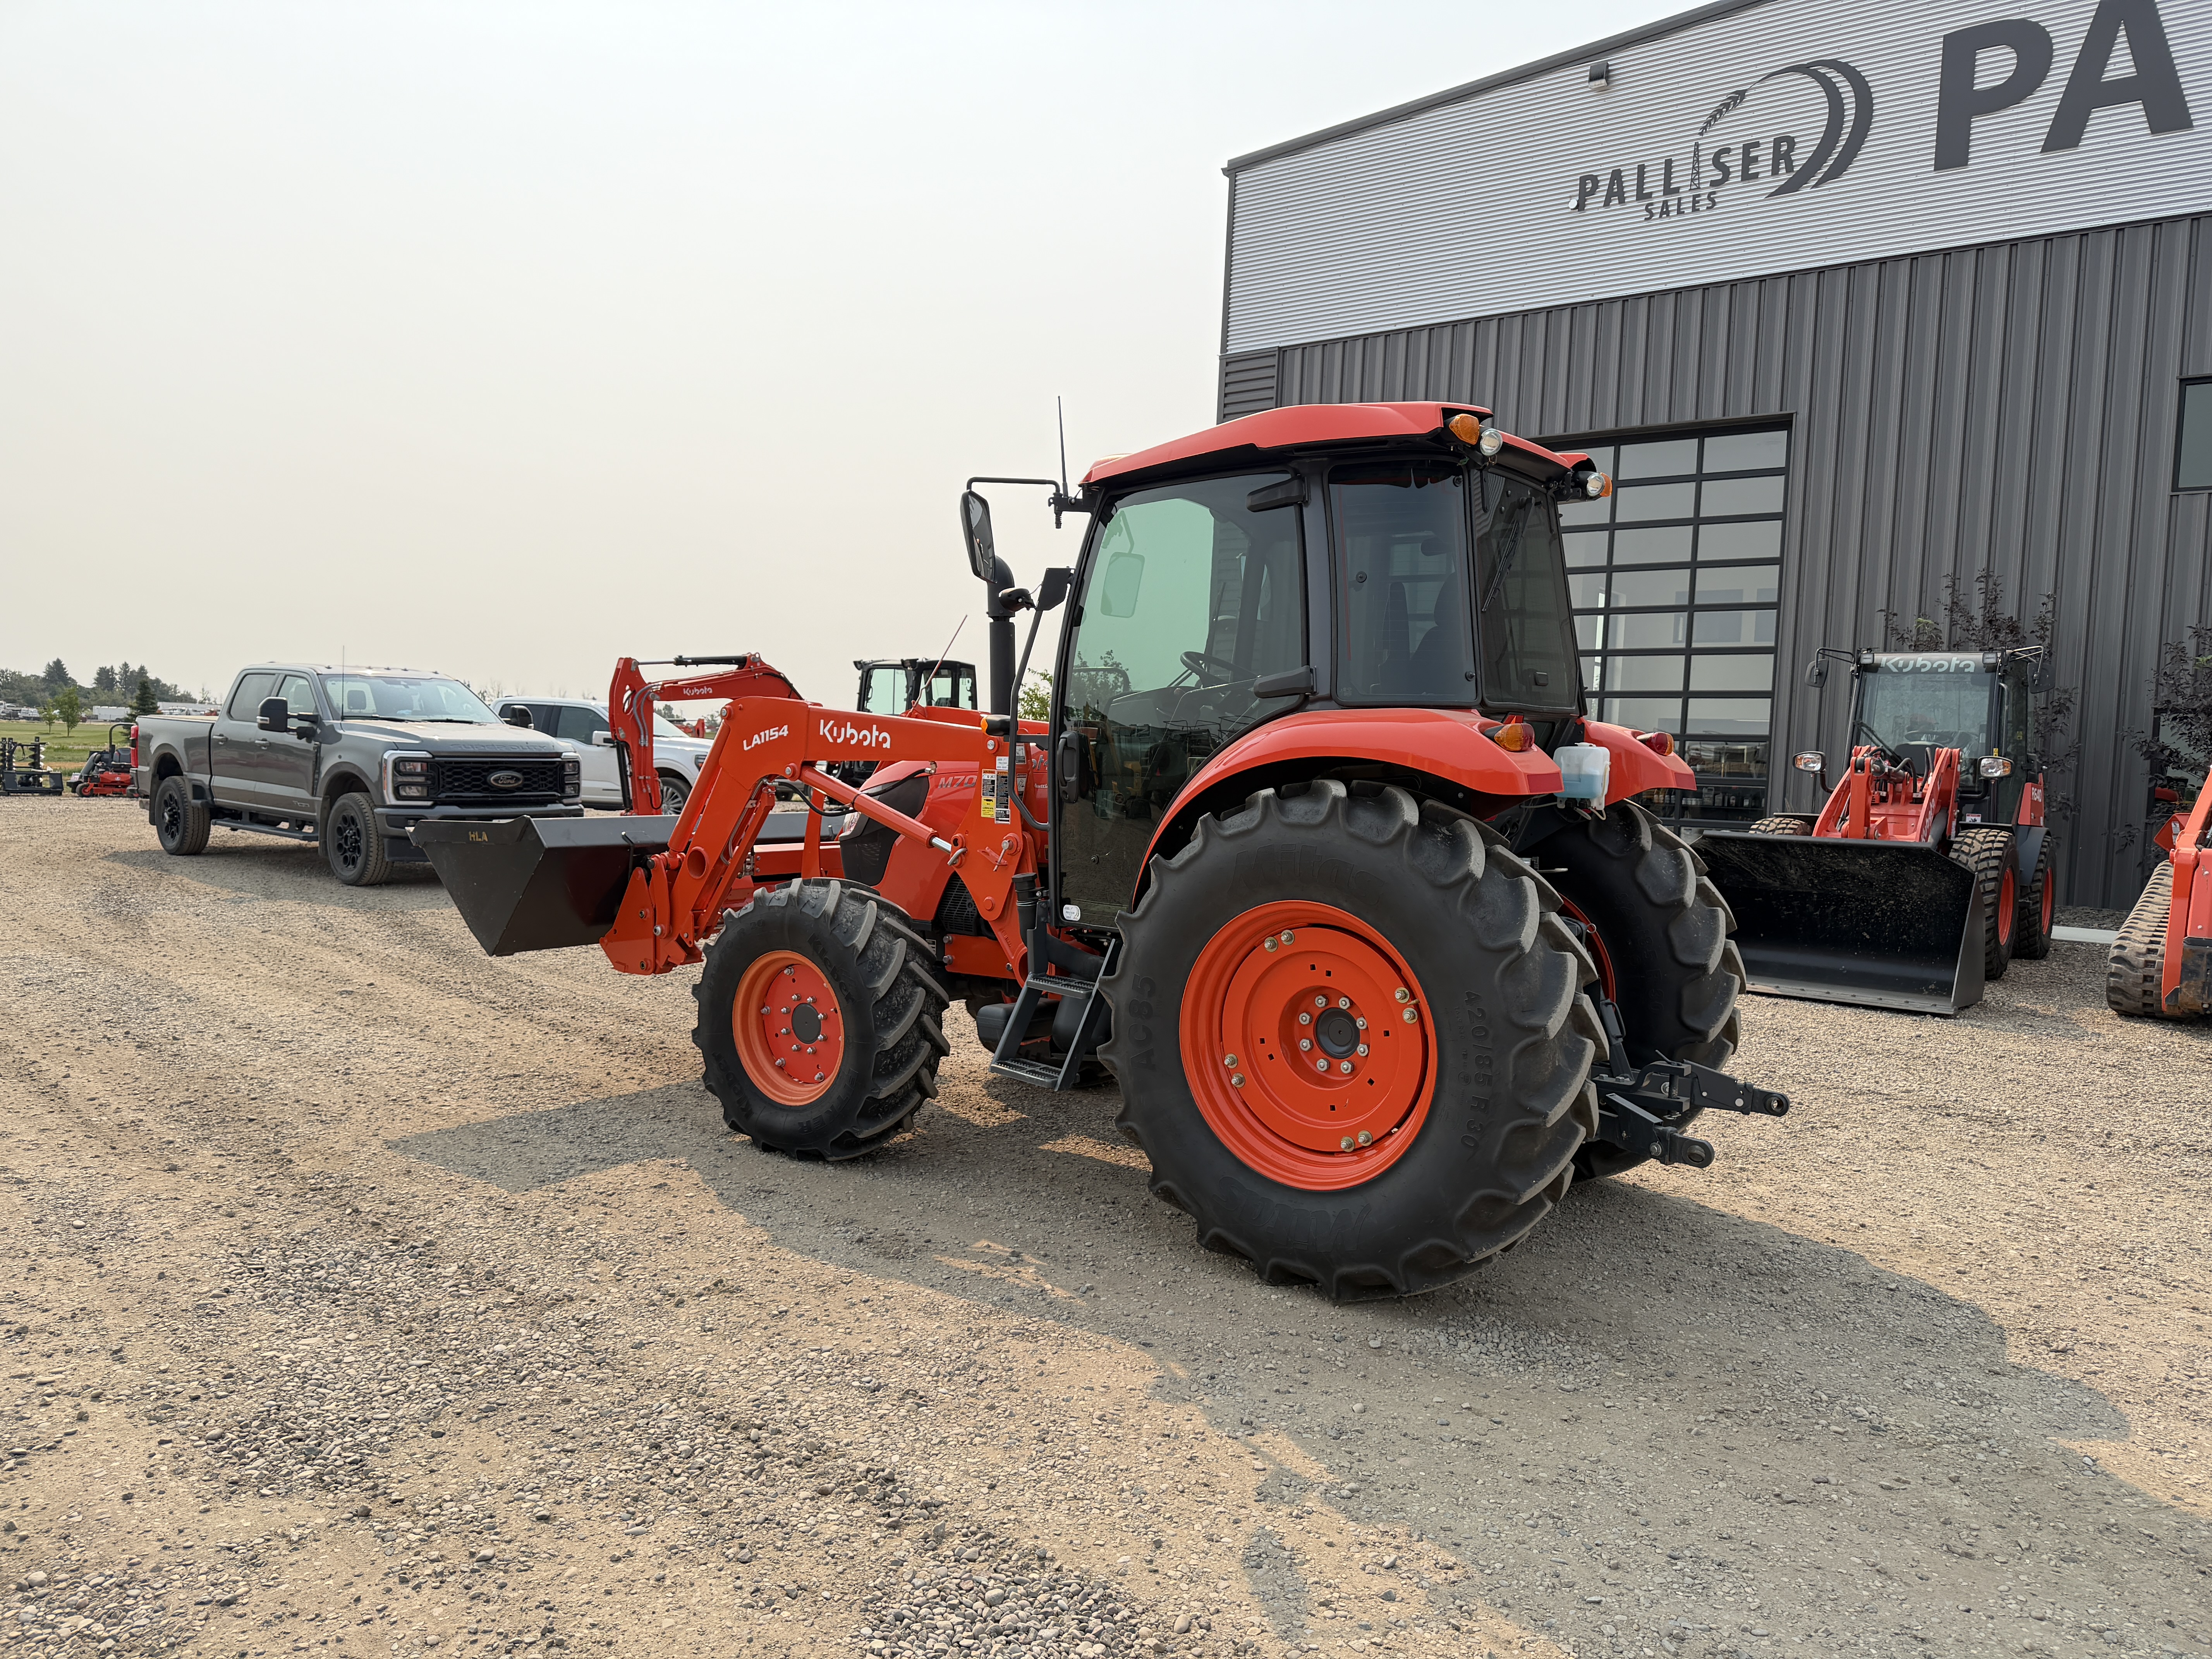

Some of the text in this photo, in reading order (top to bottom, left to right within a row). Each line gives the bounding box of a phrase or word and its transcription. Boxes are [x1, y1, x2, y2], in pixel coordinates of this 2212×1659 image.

[1934, 0, 2194, 171] PA
[1577, 135, 1796, 211] PALLISER
[1644, 191, 1716, 221] SALES
[1881, 657, 1975, 673] Kubota
[683, 686, 713, 696] Kubota
[743, 725, 788, 751] LA1154
[819, 719, 890, 749] Kubota
[498, 776, 516, 784] Ford
[2032, 787, 2042, 802] R640
[469, 831, 488, 842] HLA
[1227, 844, 1385, 905] Mitas
[807, 933, 855, 1004] Kleber
[1128, 974, 1156, 1072] AC85
[712, 1051, 753, 1120] Kleber
[1460, 990, 1494, 1149] 420/85 R 30
[1211, 1176, 1372, 1253] Mitas
